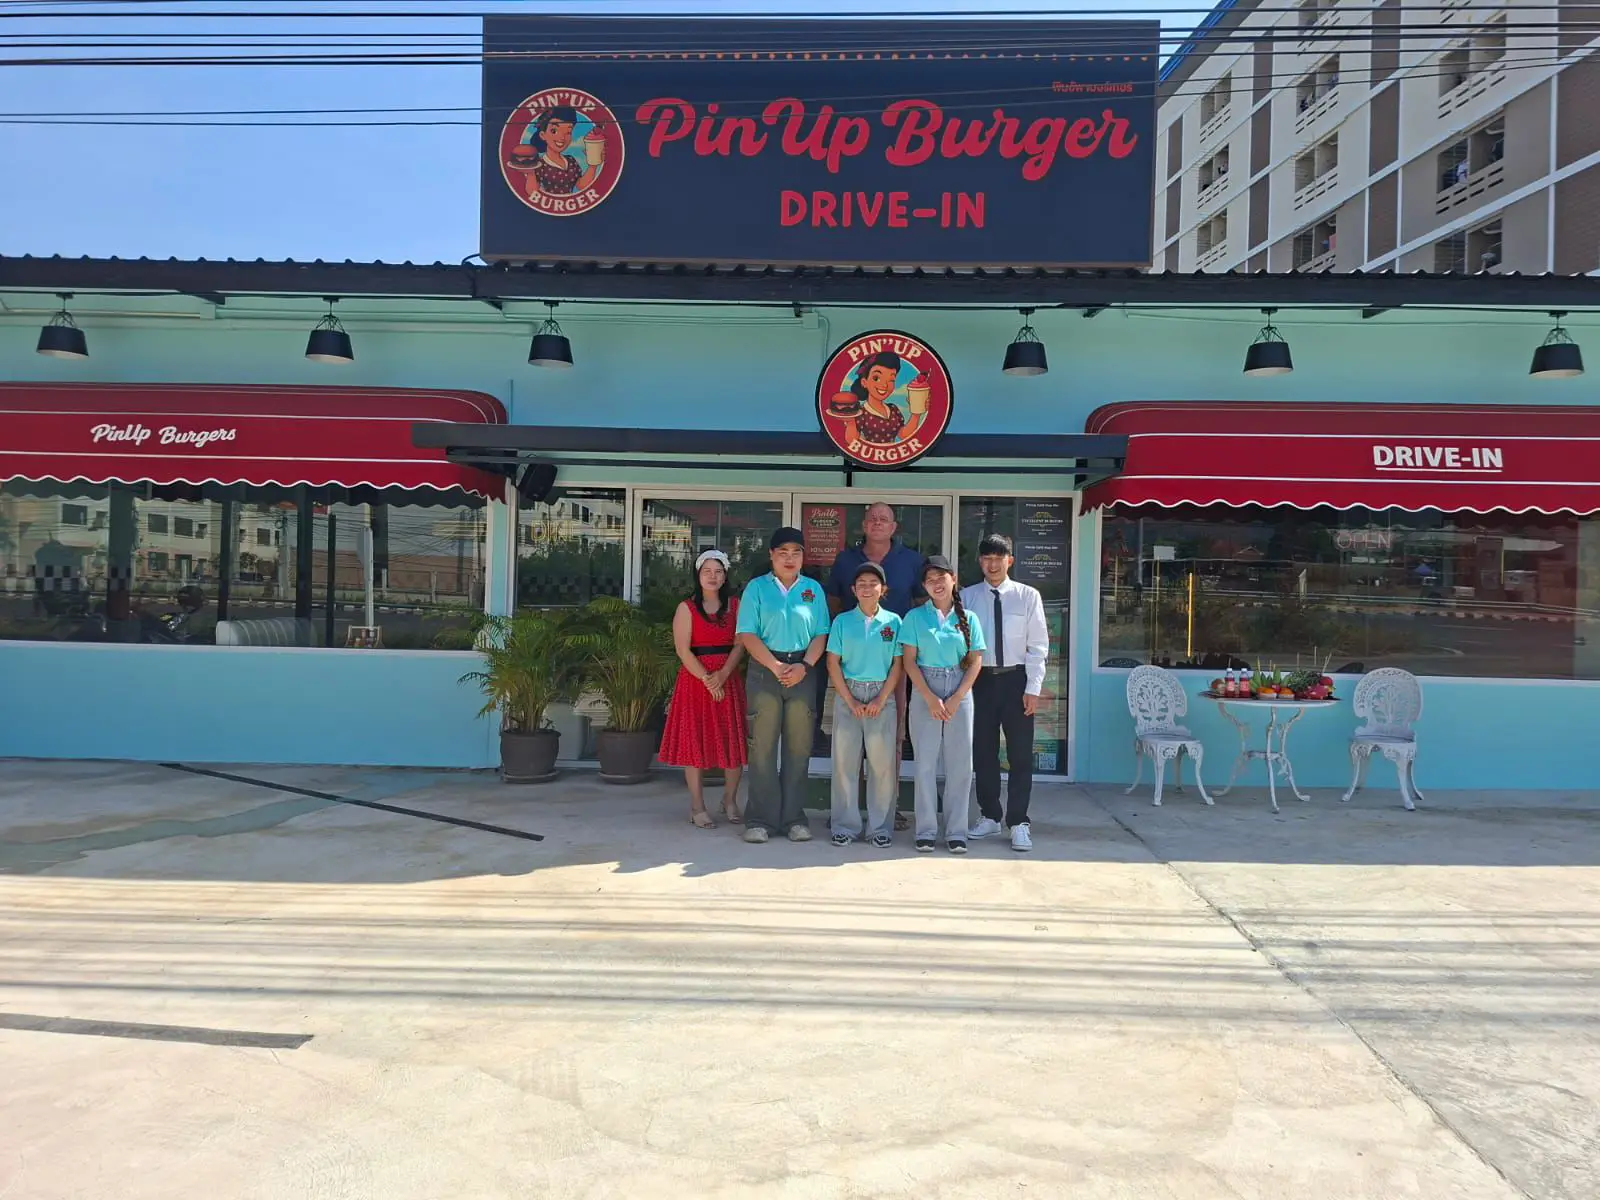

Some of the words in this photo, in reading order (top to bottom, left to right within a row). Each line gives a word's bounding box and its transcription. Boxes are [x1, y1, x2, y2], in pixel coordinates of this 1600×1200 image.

[881, 99, 1138, 181] Burger
[528, 188, 600, 212] BURGER
[780, 190, 985, 228] DRIVE-IN
[90, 423, 152, 446] PinUp
[158, 426, 237, 448] Burgers
[848, 438, 923, 462] BURGER
[1372, 445, 1504, 468] DRIVE-IN
[1336, 530, 1391, 549] OPEN
